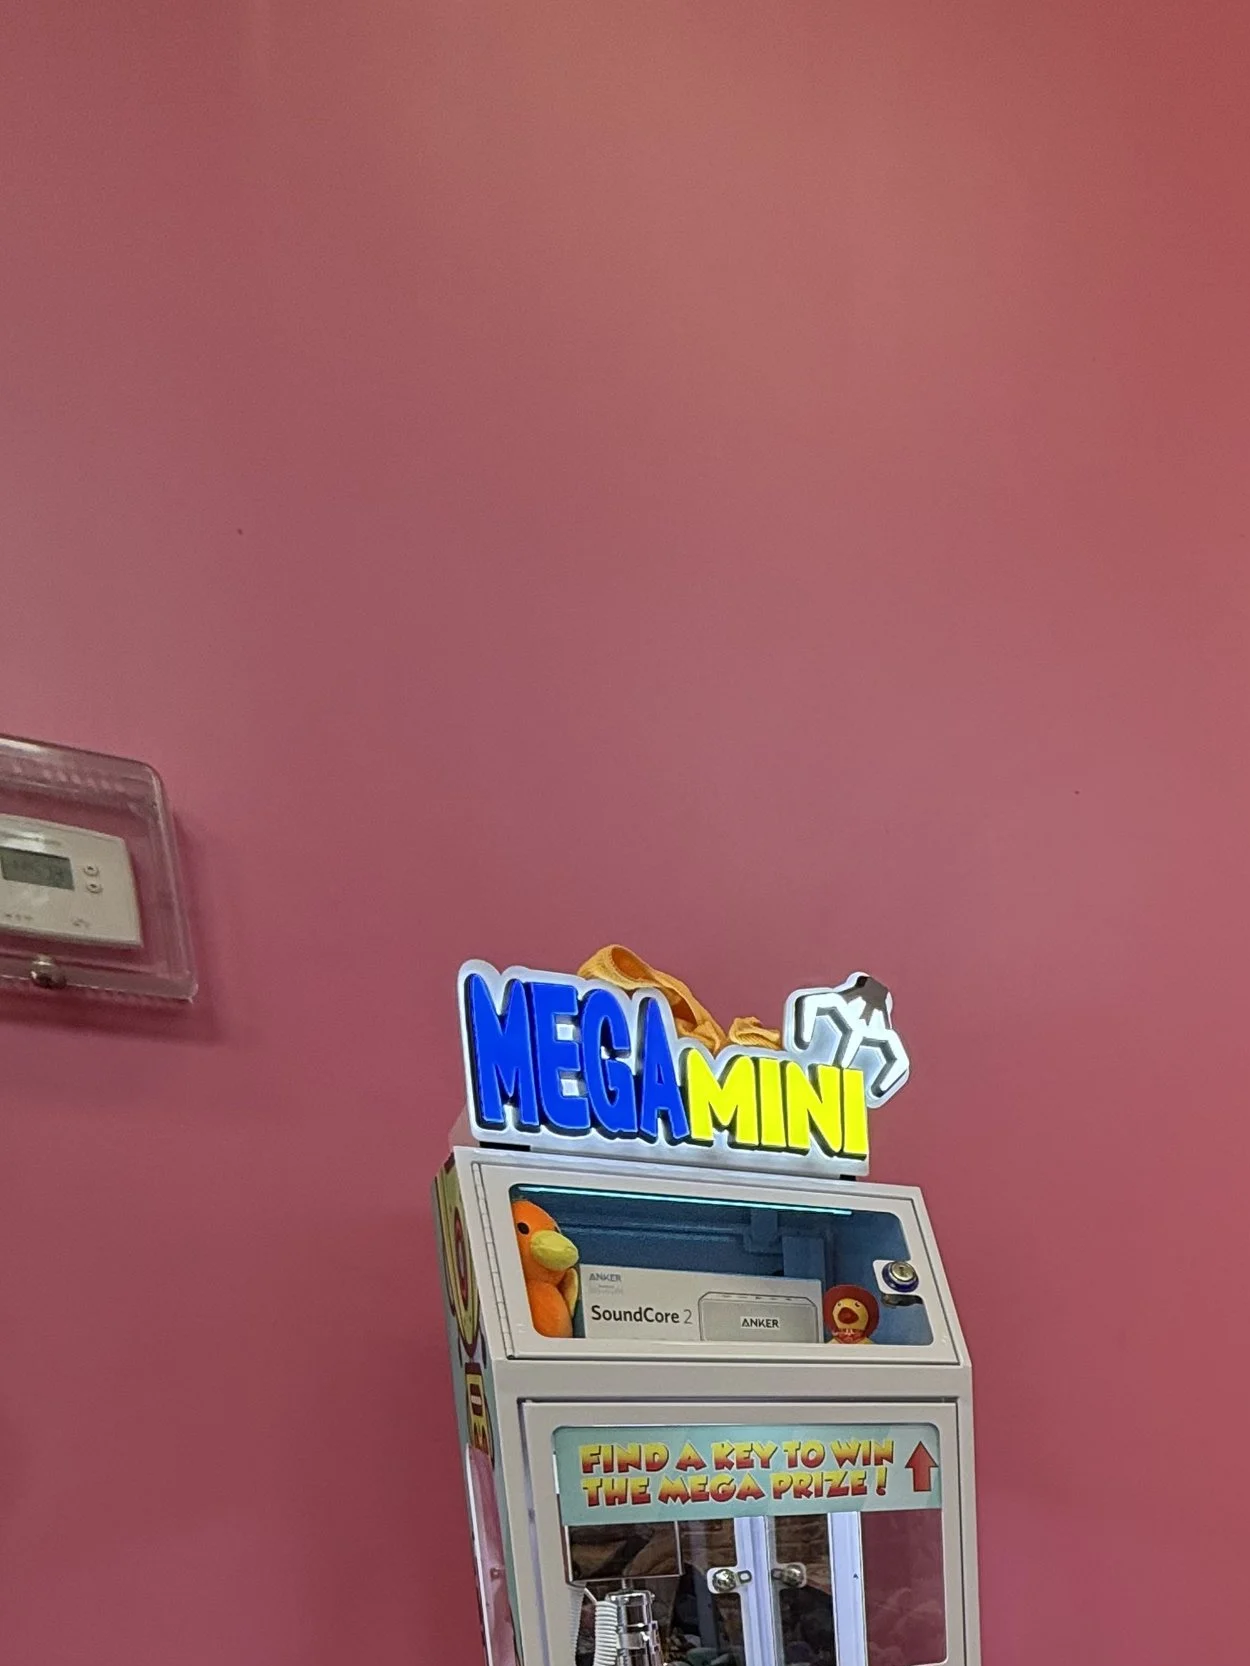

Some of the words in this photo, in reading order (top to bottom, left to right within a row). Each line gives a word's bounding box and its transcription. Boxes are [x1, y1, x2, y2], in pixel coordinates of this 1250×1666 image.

[588, 1273, 622, 1282] ANKER
[591, 1305, 680, 1324] SoundCore
[683, 1308, 693, 1325] 2
[741, 1317, 779, 1328] ANKER
[579, 1443, 670, 1474] FIND
[675, 1441, 707, 1471] A
[711, 1440, 778, 1471] KEY
[783, 1440, 826, 1469] TO
[831, 1439, 894, 1468] WIN
[582, 1476, 651, 1508] THE
[657, 1474, 766, 1504] MEGA
